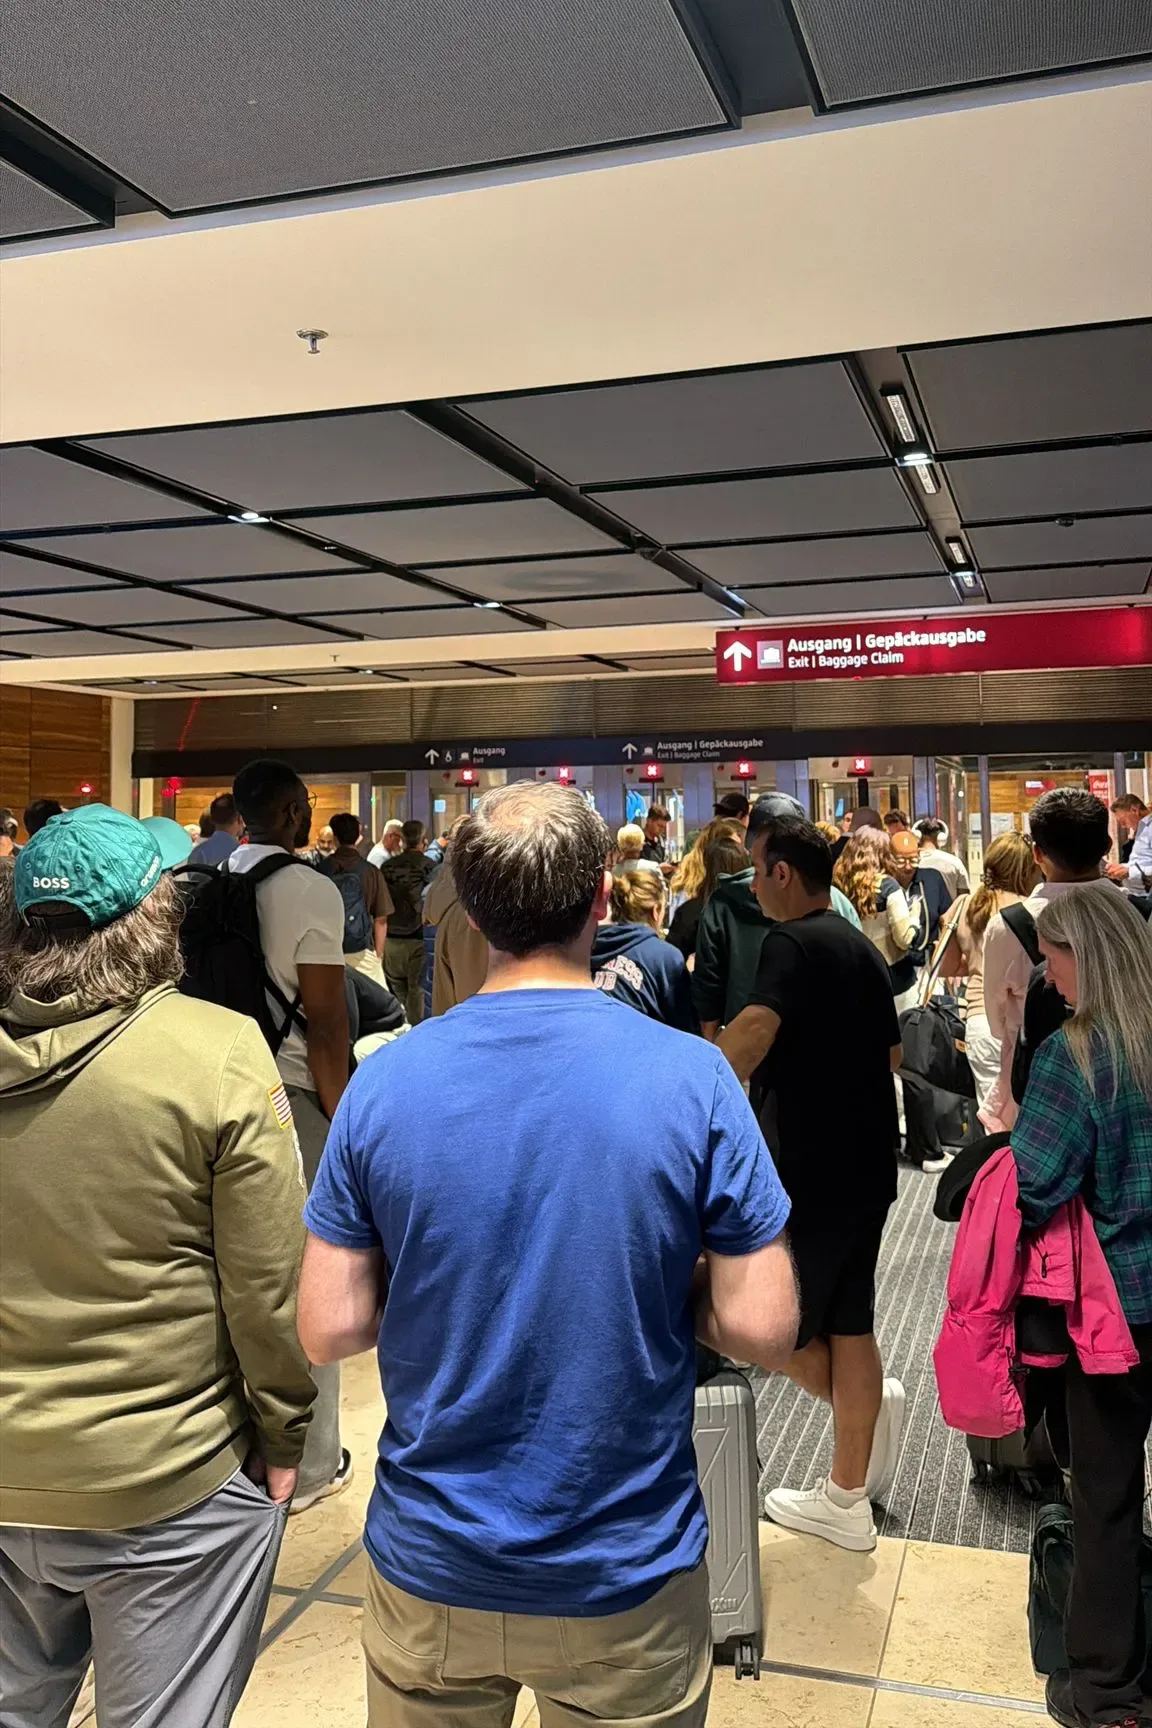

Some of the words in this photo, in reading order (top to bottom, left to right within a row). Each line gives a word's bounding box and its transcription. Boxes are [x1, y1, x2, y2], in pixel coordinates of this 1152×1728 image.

[787, 636, 852, 654] Ausgang
[865, 628, 986, 650] Gepäckausgabe
[788, 656, 809, 668] Exit
[818, 653, 868, 669] Baggage
[871, 651, 904, 664] Claim
[657, 741, 693, 751] Ausgang
[699, 738, 764, 750] Gepäckausgabe
[472, 747, 506, 757] Ausgang
[32, 876, 70, 889] BOSS
